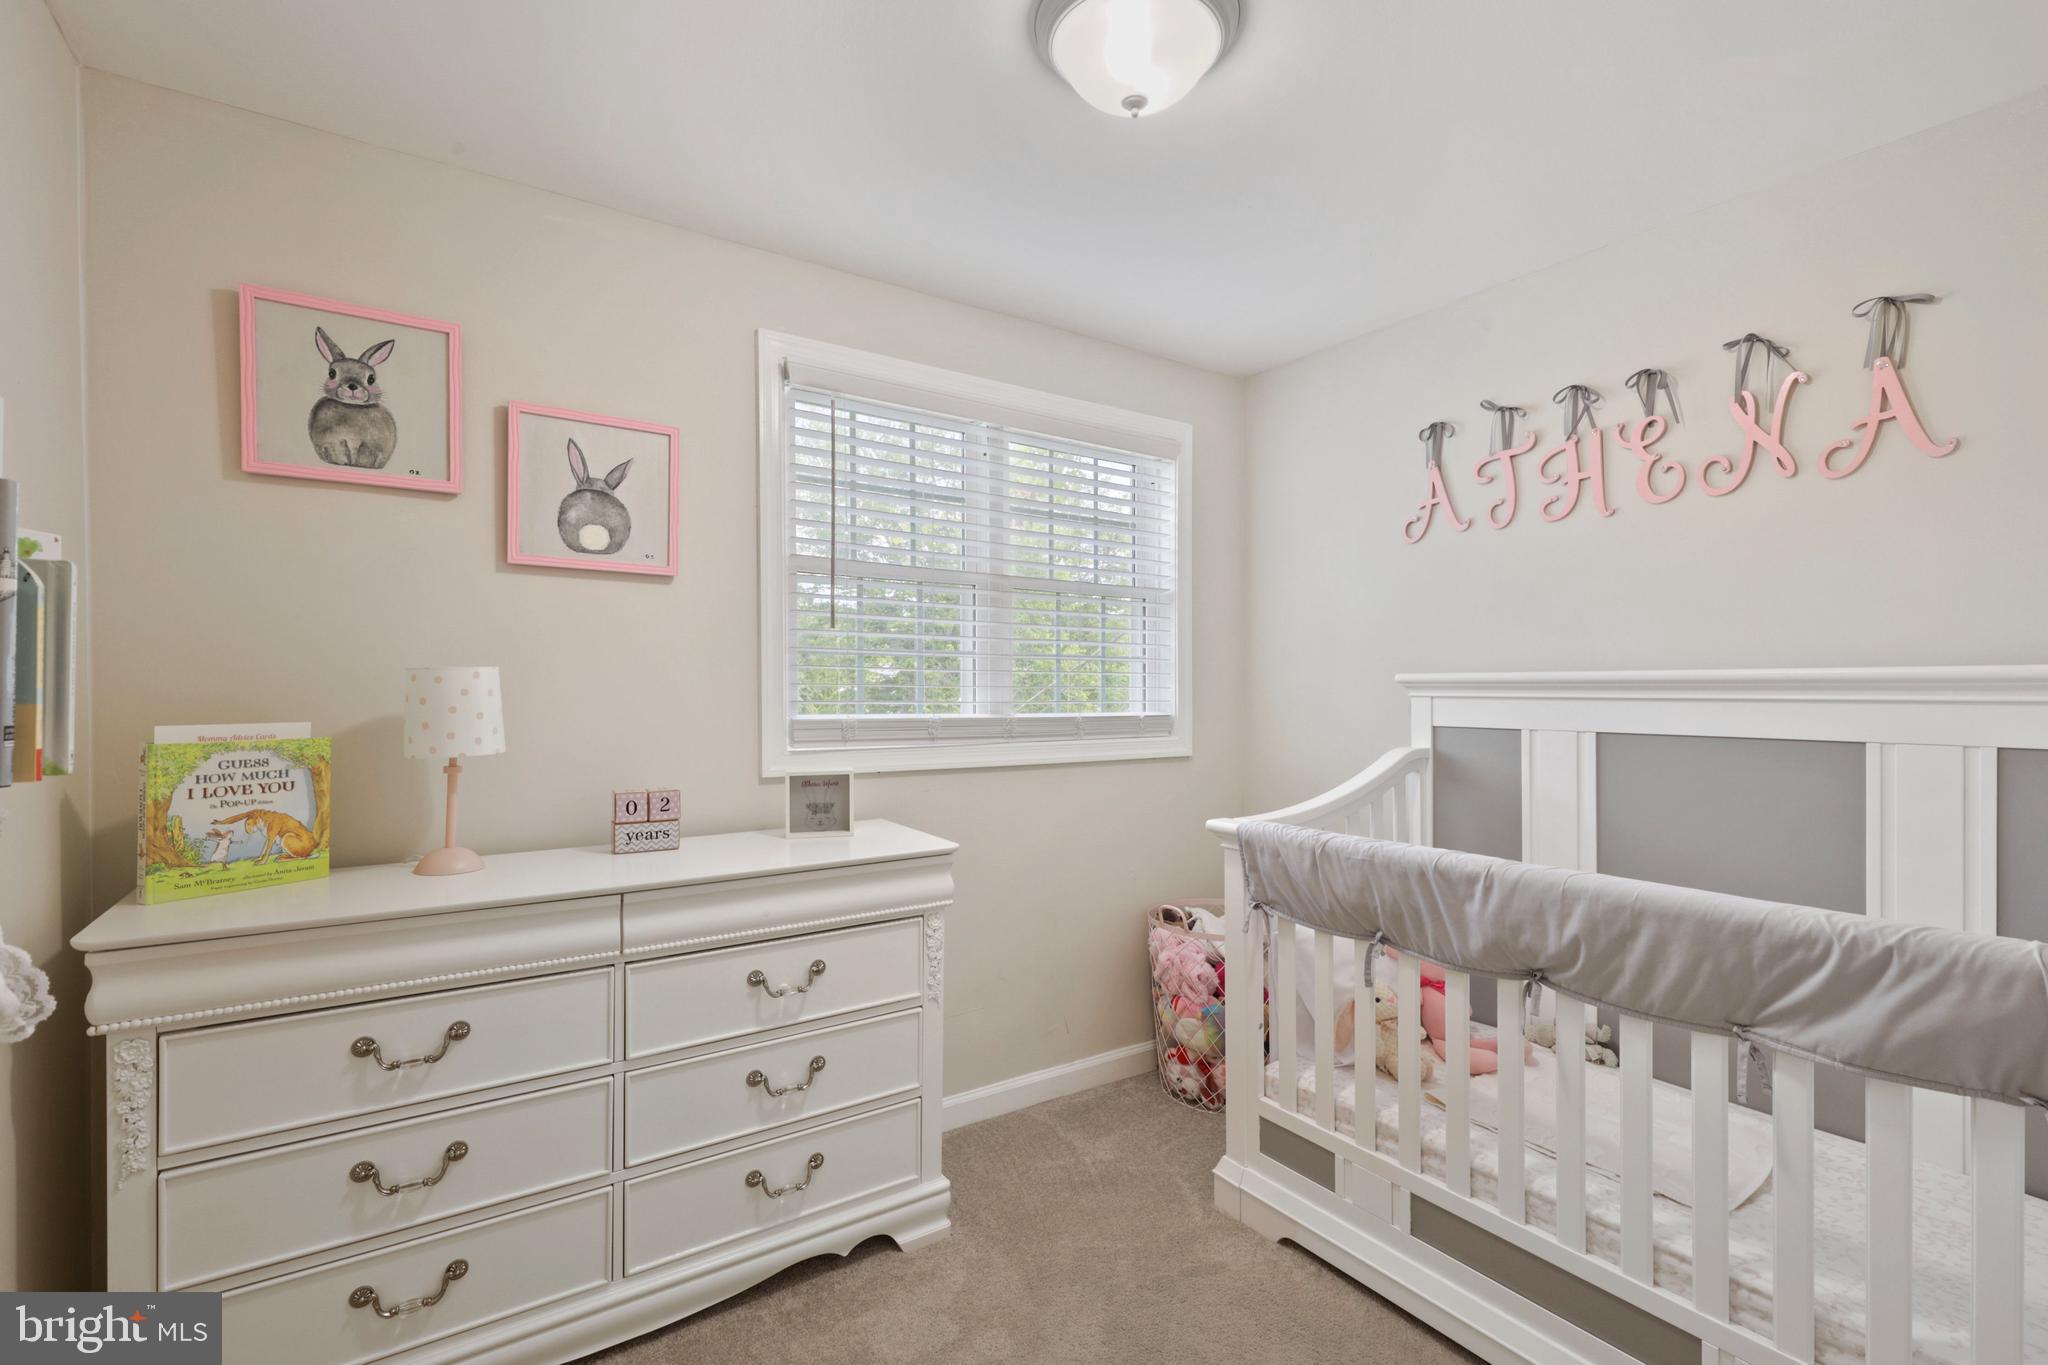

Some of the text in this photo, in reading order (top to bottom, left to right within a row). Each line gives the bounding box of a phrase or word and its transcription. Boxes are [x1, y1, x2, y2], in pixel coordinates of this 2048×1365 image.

[1402, 356, 1958, 544] ATHENA
[218, 758, 269, 770] GUESS
[195, 769, 289, 784] HOW MUCH
[187, 781, 295, 800] I LOVE YOU
[220, 799, 257, 808] POP-UP
[624, 828, 670, 845] years
[174, 882, 191, 890] Sam
